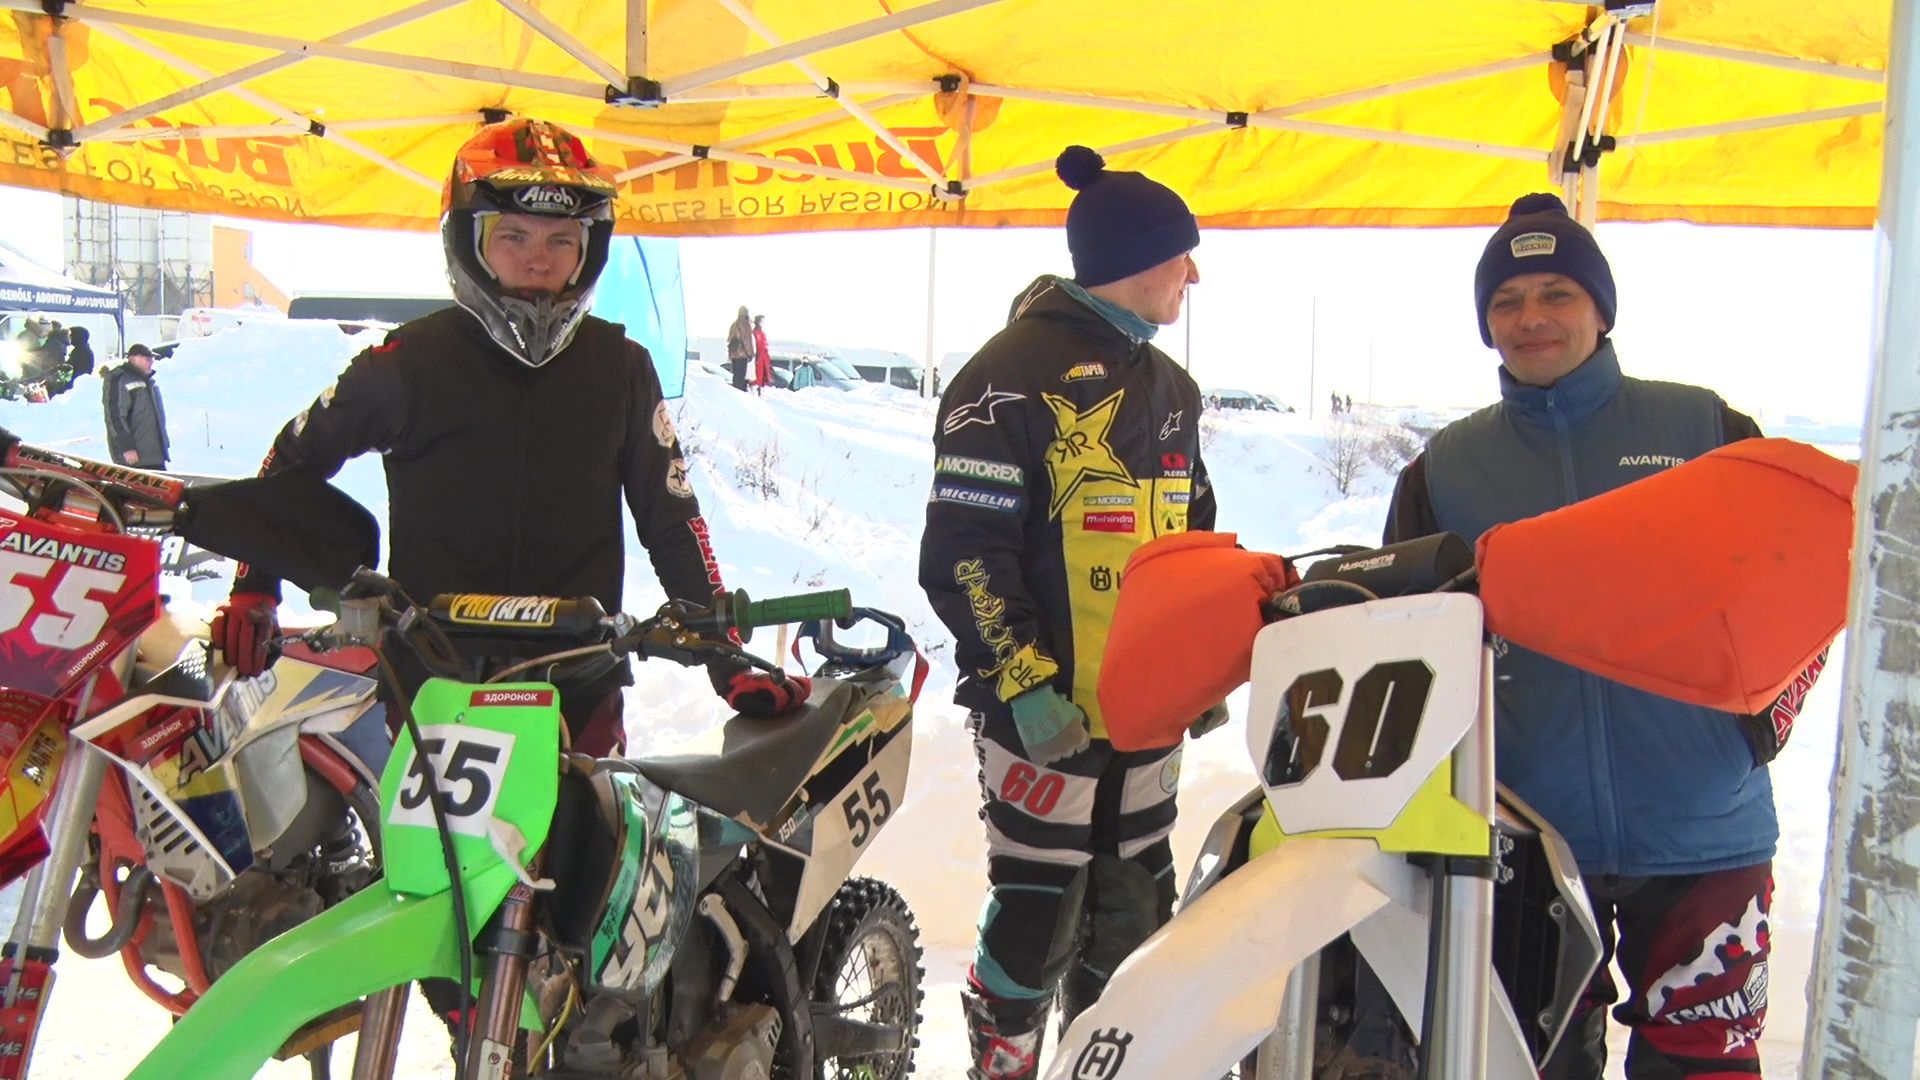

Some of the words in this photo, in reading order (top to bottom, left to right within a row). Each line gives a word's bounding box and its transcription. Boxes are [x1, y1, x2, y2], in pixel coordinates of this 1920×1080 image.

[489, 168, 544, 182] Airoh
[521, 185, 574, 206] Airoh
[943, 457, 1021, 482] MOTOREX
[939, 487, 1017, 509] MICHELIN
[0, 531, 126, 573] AVANTIS
[67, 640, 109, 677] ЗДОРОНОК
[484, 693, 538, 702] ЗДОРОНОК
[141, 719, 184, 749] ЗДОРОНОК
[1261, 656, 1436, 789] 60
[400, 738, 501, 817] 55
[1000, 761, 1066, 817] 60
[842, 770, 892, 848] 55
